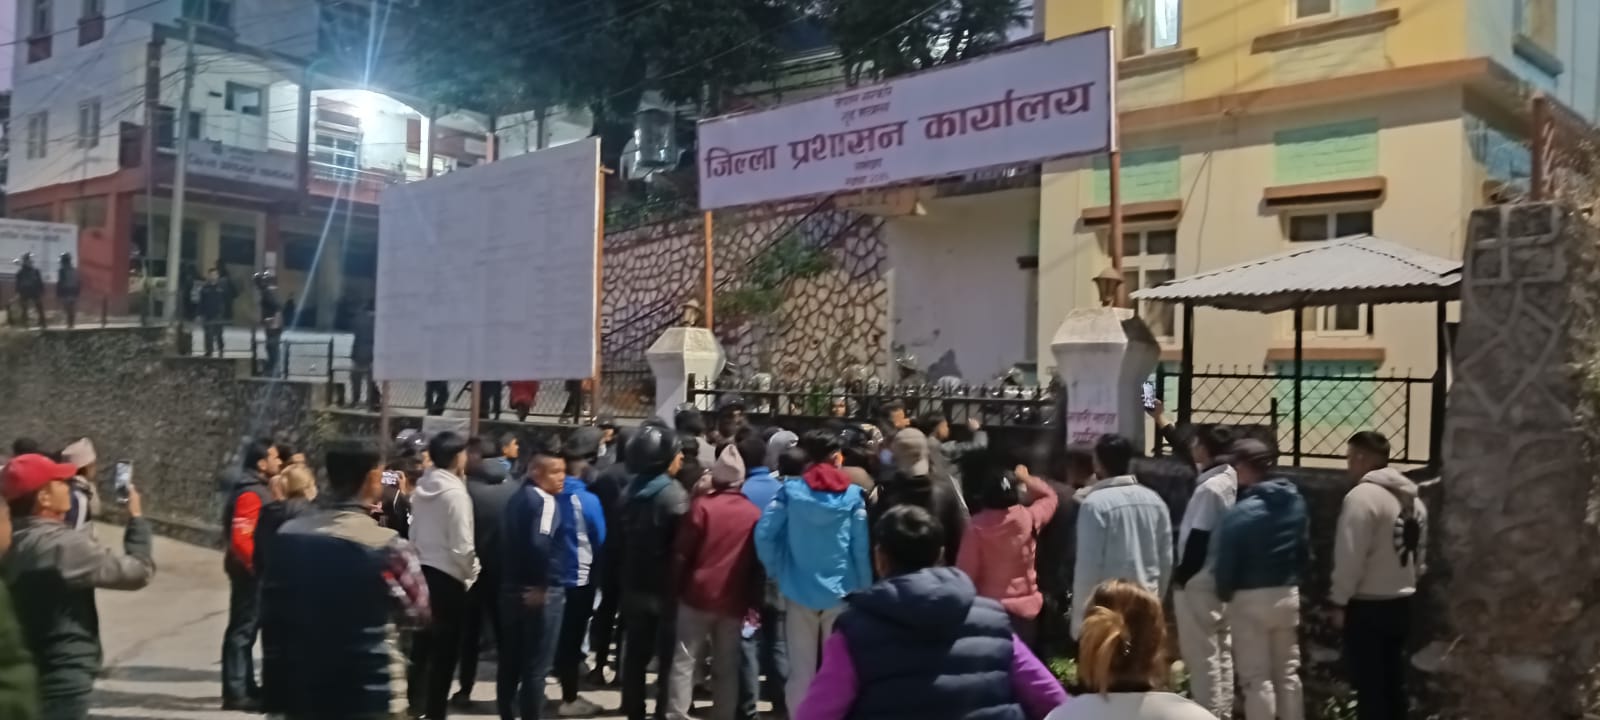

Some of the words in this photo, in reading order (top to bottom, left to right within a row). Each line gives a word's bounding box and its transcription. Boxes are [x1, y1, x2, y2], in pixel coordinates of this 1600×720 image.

[704, 145, 779, 179] जिल्ला
[787, 120, 908, 170] प्रशासन
[918, 81, 1096, 140] कार्यालय
